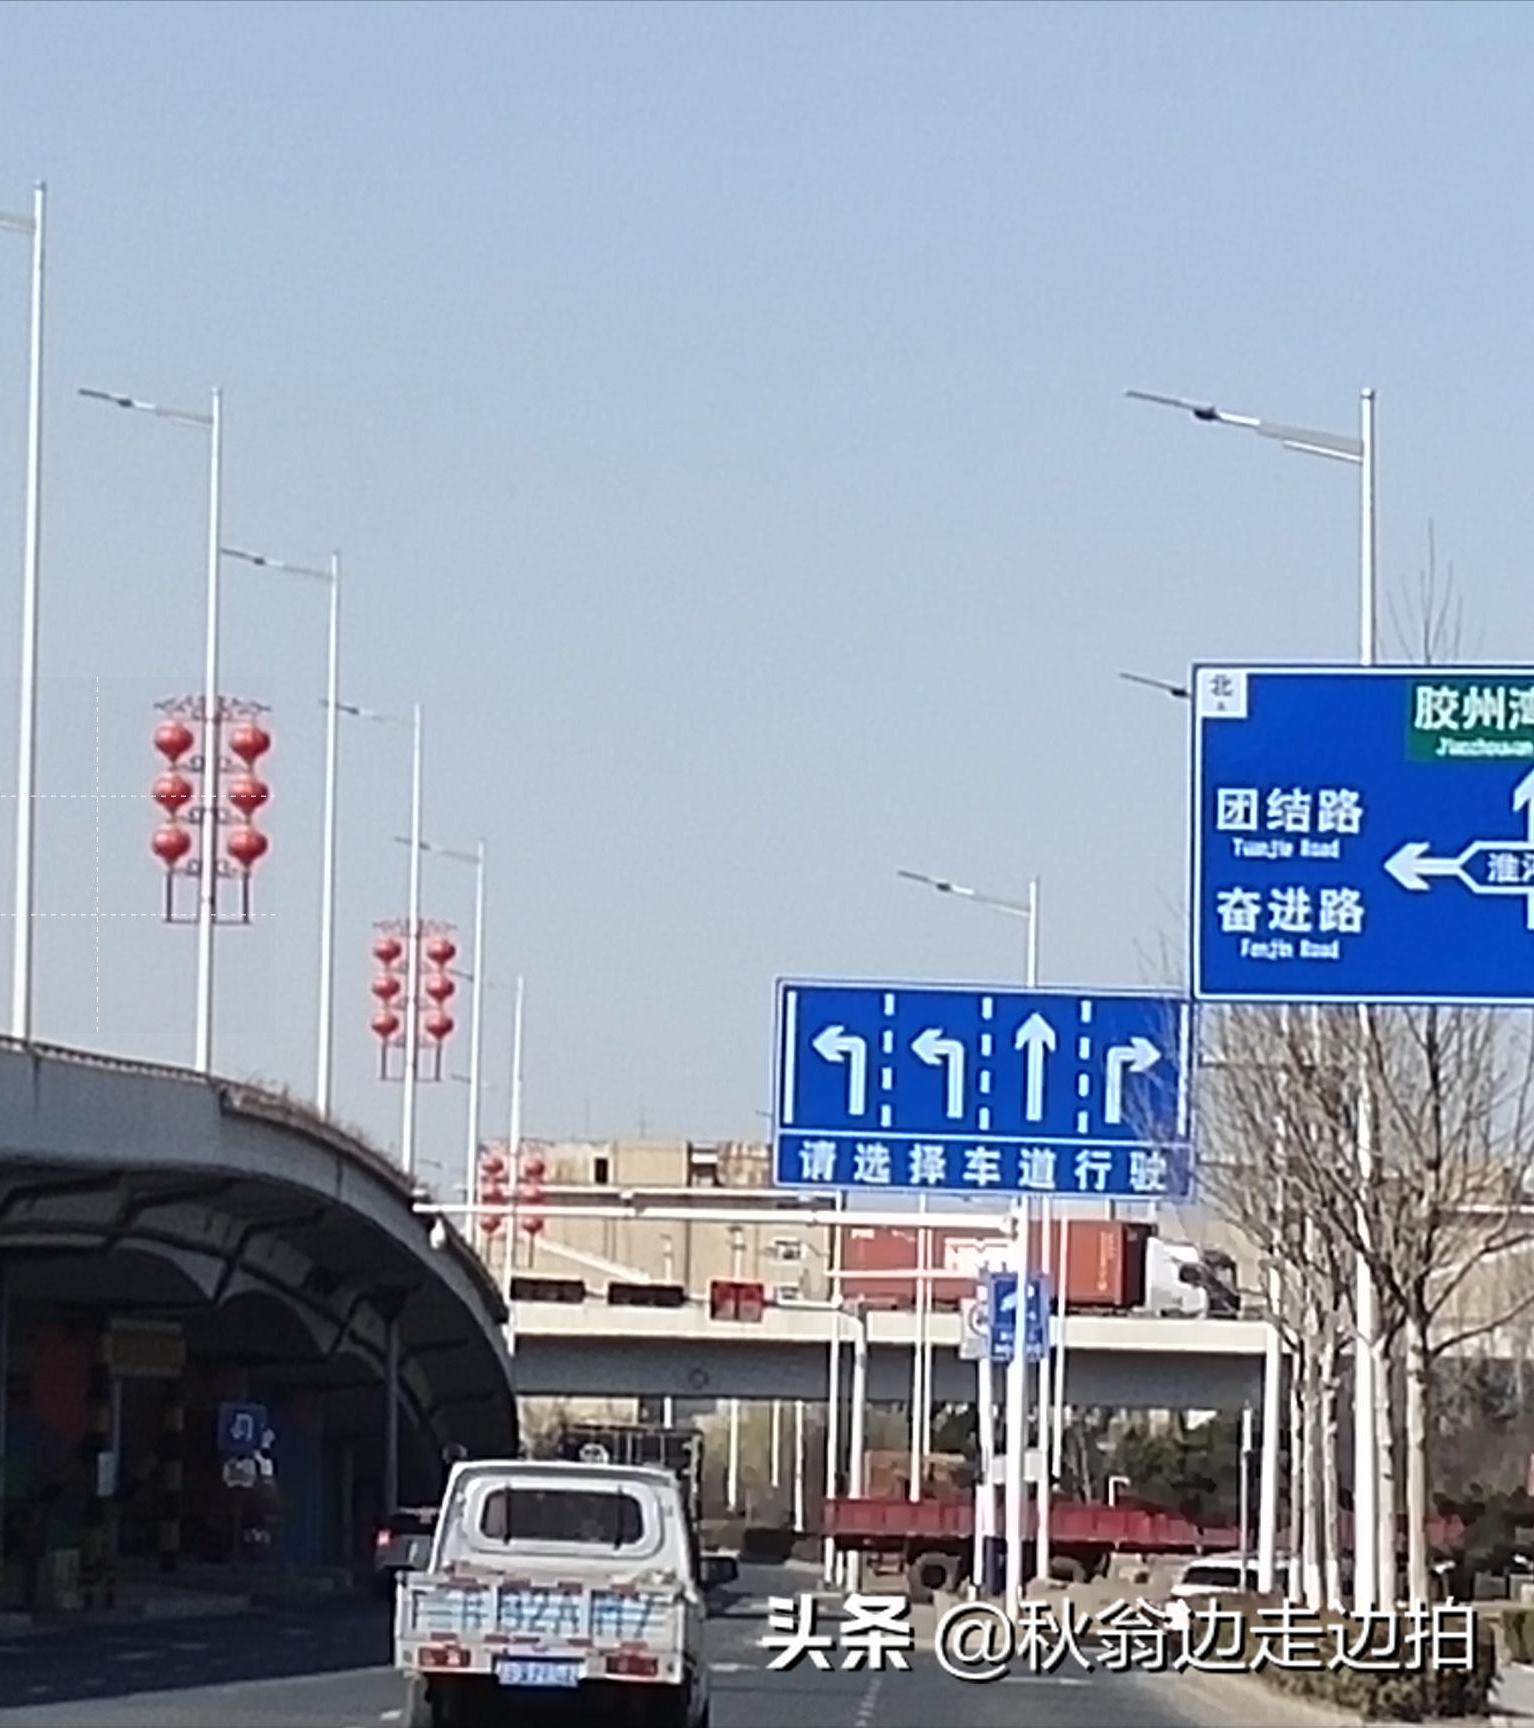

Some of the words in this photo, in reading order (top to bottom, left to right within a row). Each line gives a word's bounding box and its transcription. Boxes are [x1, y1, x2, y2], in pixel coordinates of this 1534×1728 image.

[1209, 673, 1234, 697] 北
[1217, 788, 1363, 834] 团结路
[1300, 838, 1340, 858] Road
[1217, 887, 1364, 932] 奋进路
[1300, 939, 1339, 959] Road
[799, 1140, 1168, 1191] 请选择车道行驶
